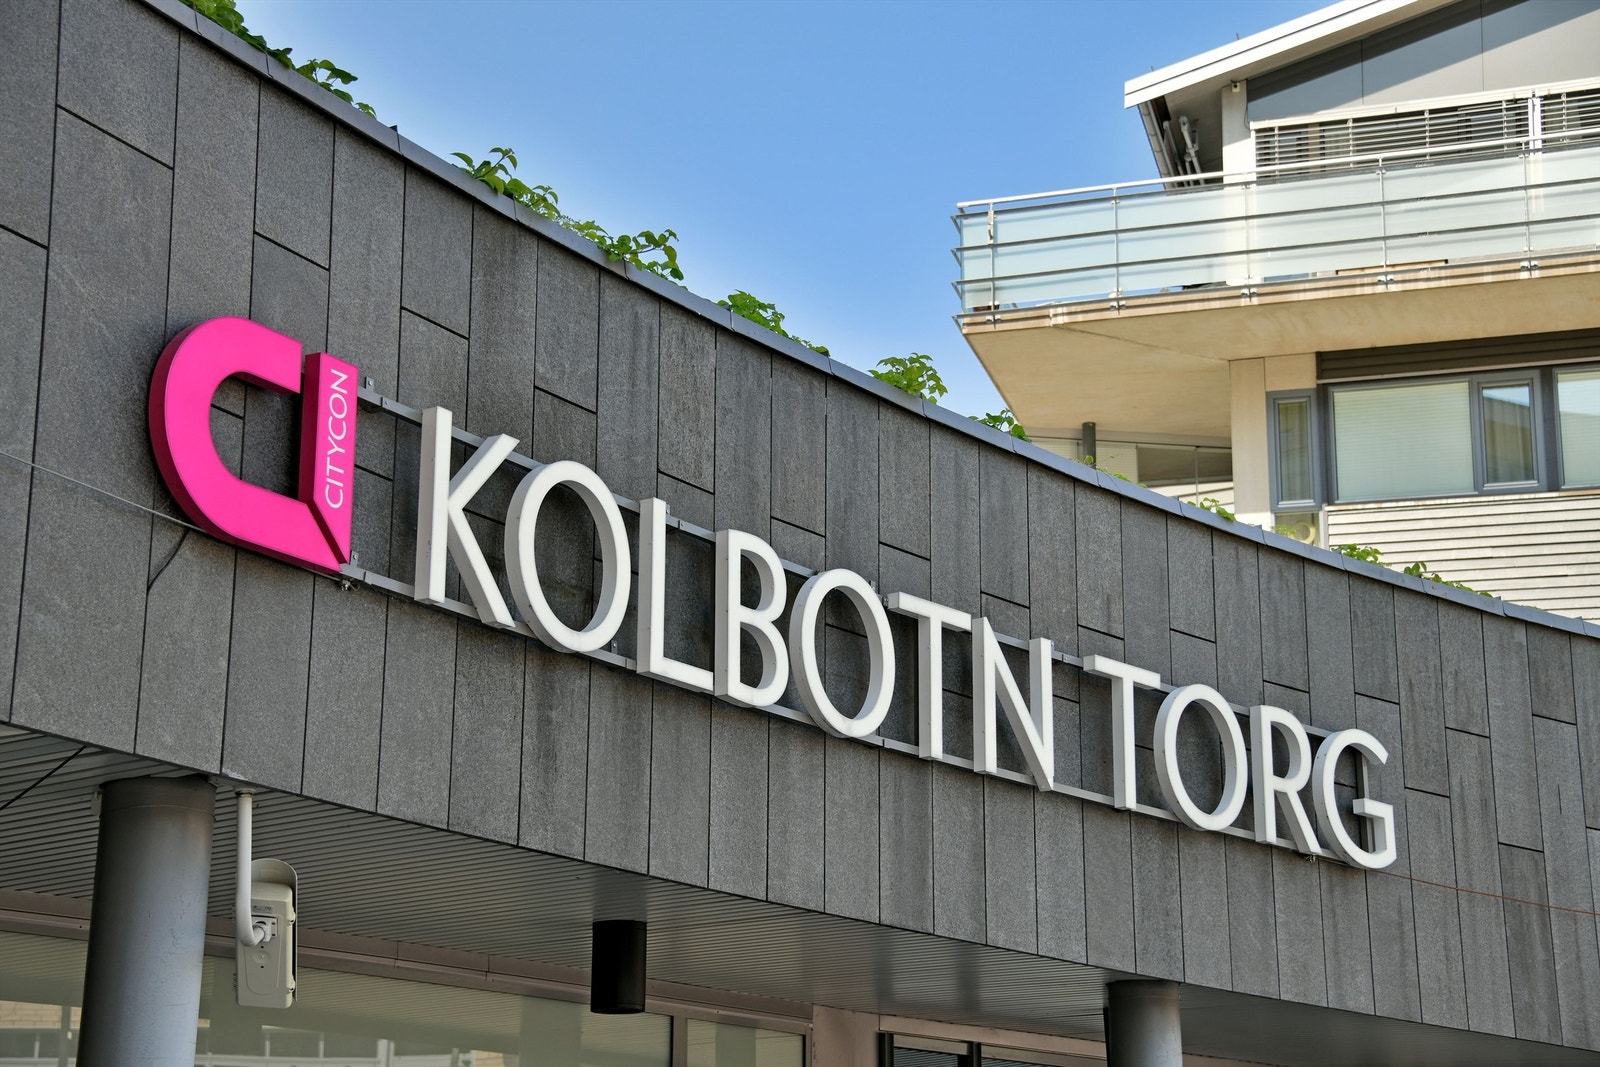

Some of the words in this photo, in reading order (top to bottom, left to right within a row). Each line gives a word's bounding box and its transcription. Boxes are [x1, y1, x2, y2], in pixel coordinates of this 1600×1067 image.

[325, 368, 349, 509] CITYCON
[414, 406, 1054, 792] KOLBOTN
[1083, 653, 1398, 869] TORG
